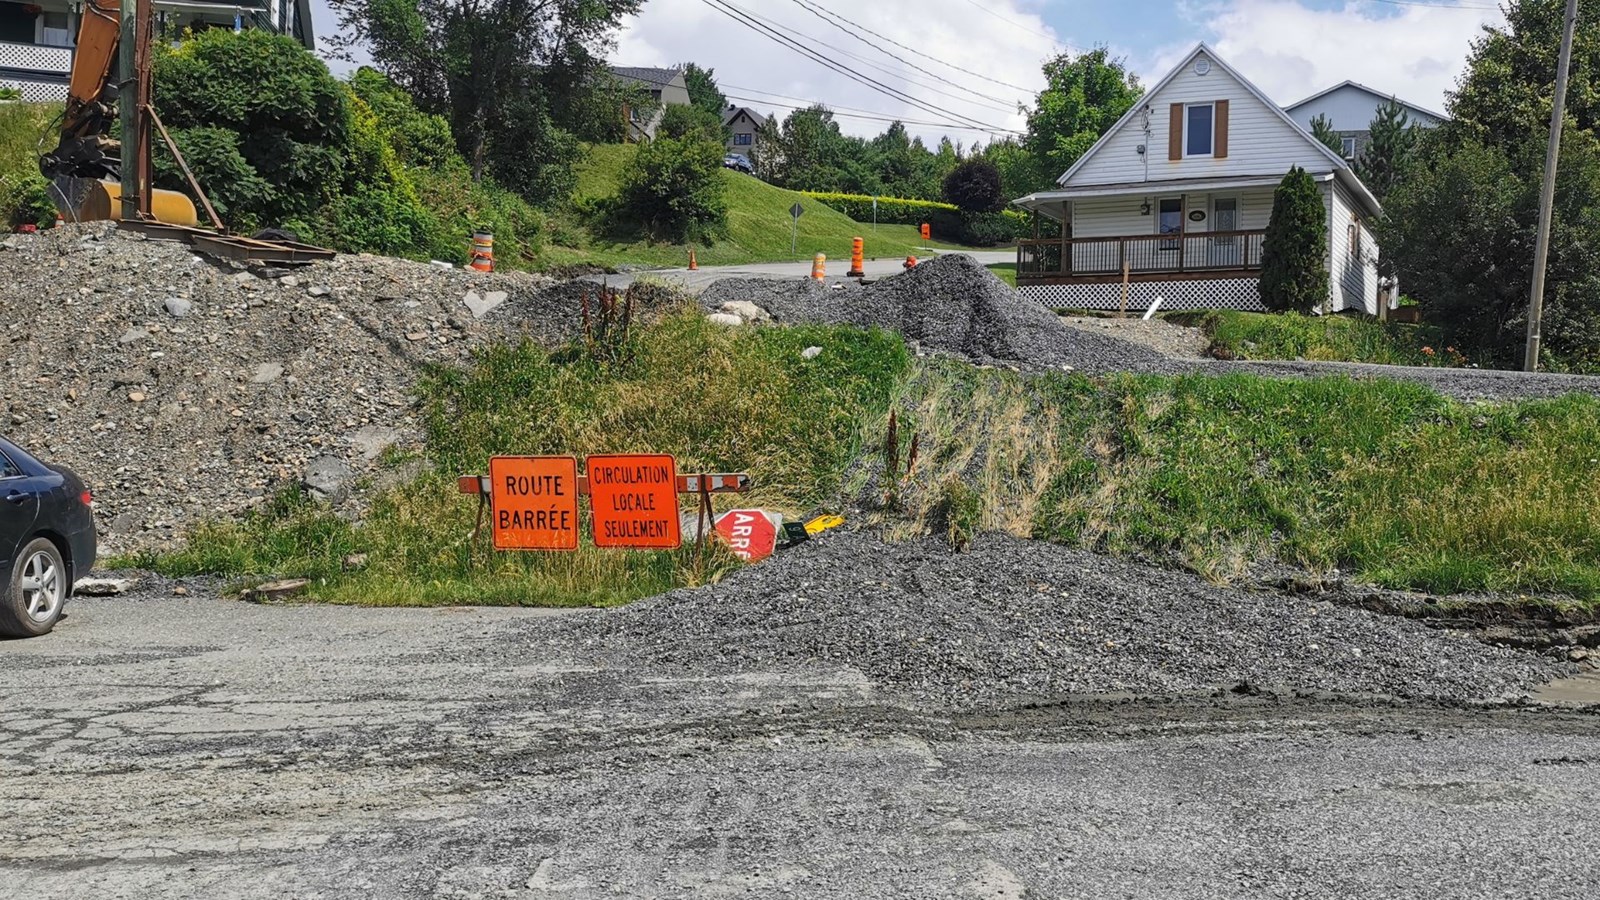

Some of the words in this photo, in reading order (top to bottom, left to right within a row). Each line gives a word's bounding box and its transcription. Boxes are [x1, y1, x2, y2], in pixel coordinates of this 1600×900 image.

[594, 466, 669, 484] CIRCULATION
[506, 476, 564, 496] ROUTE
[613, 493, 656, 511] LOCALE
[500, 504, 571, 530] BARRÉE
[605, 521, 669, 538] SEULEMENT
